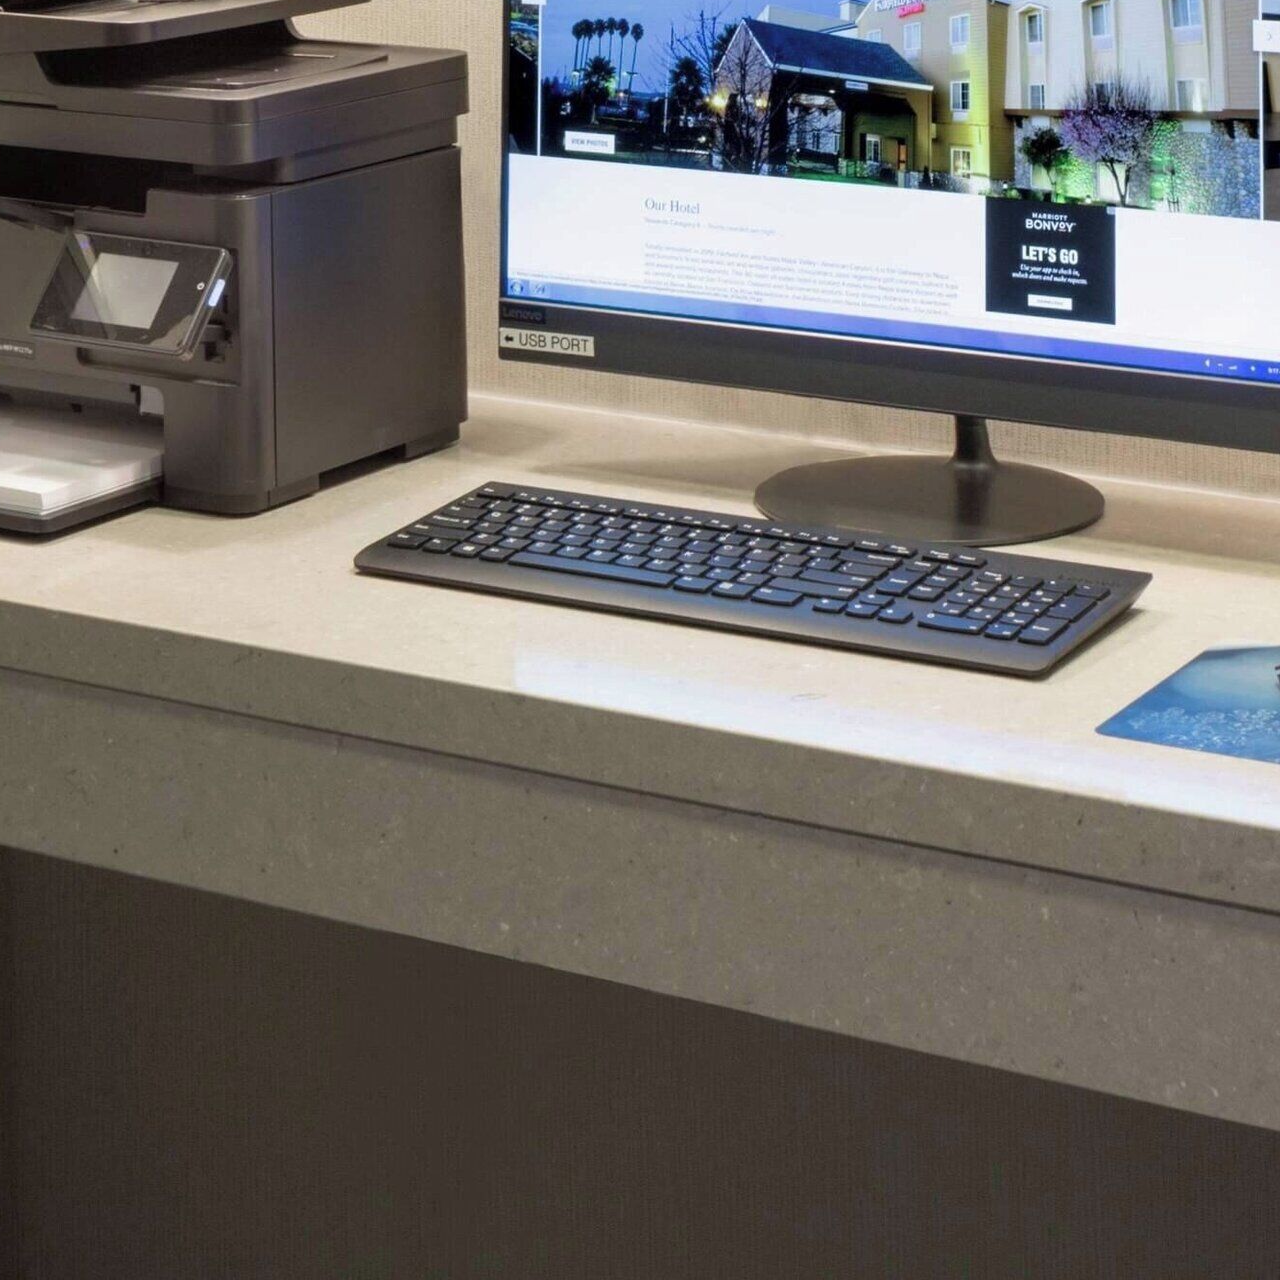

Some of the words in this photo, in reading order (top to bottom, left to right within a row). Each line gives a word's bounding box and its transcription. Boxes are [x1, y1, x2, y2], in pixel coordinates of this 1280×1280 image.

[644, 197, 666, 213] Our
[669, 199, 701, 216] Hotel
[1032, 212, 1068, 221] MARRIOTT
[1022, 245, 1057, 263] LET'S
[1060, 249, 1078, 265] GO
[519, 332, 547, 348] USB
[551, 335, 589, 352] PORT
